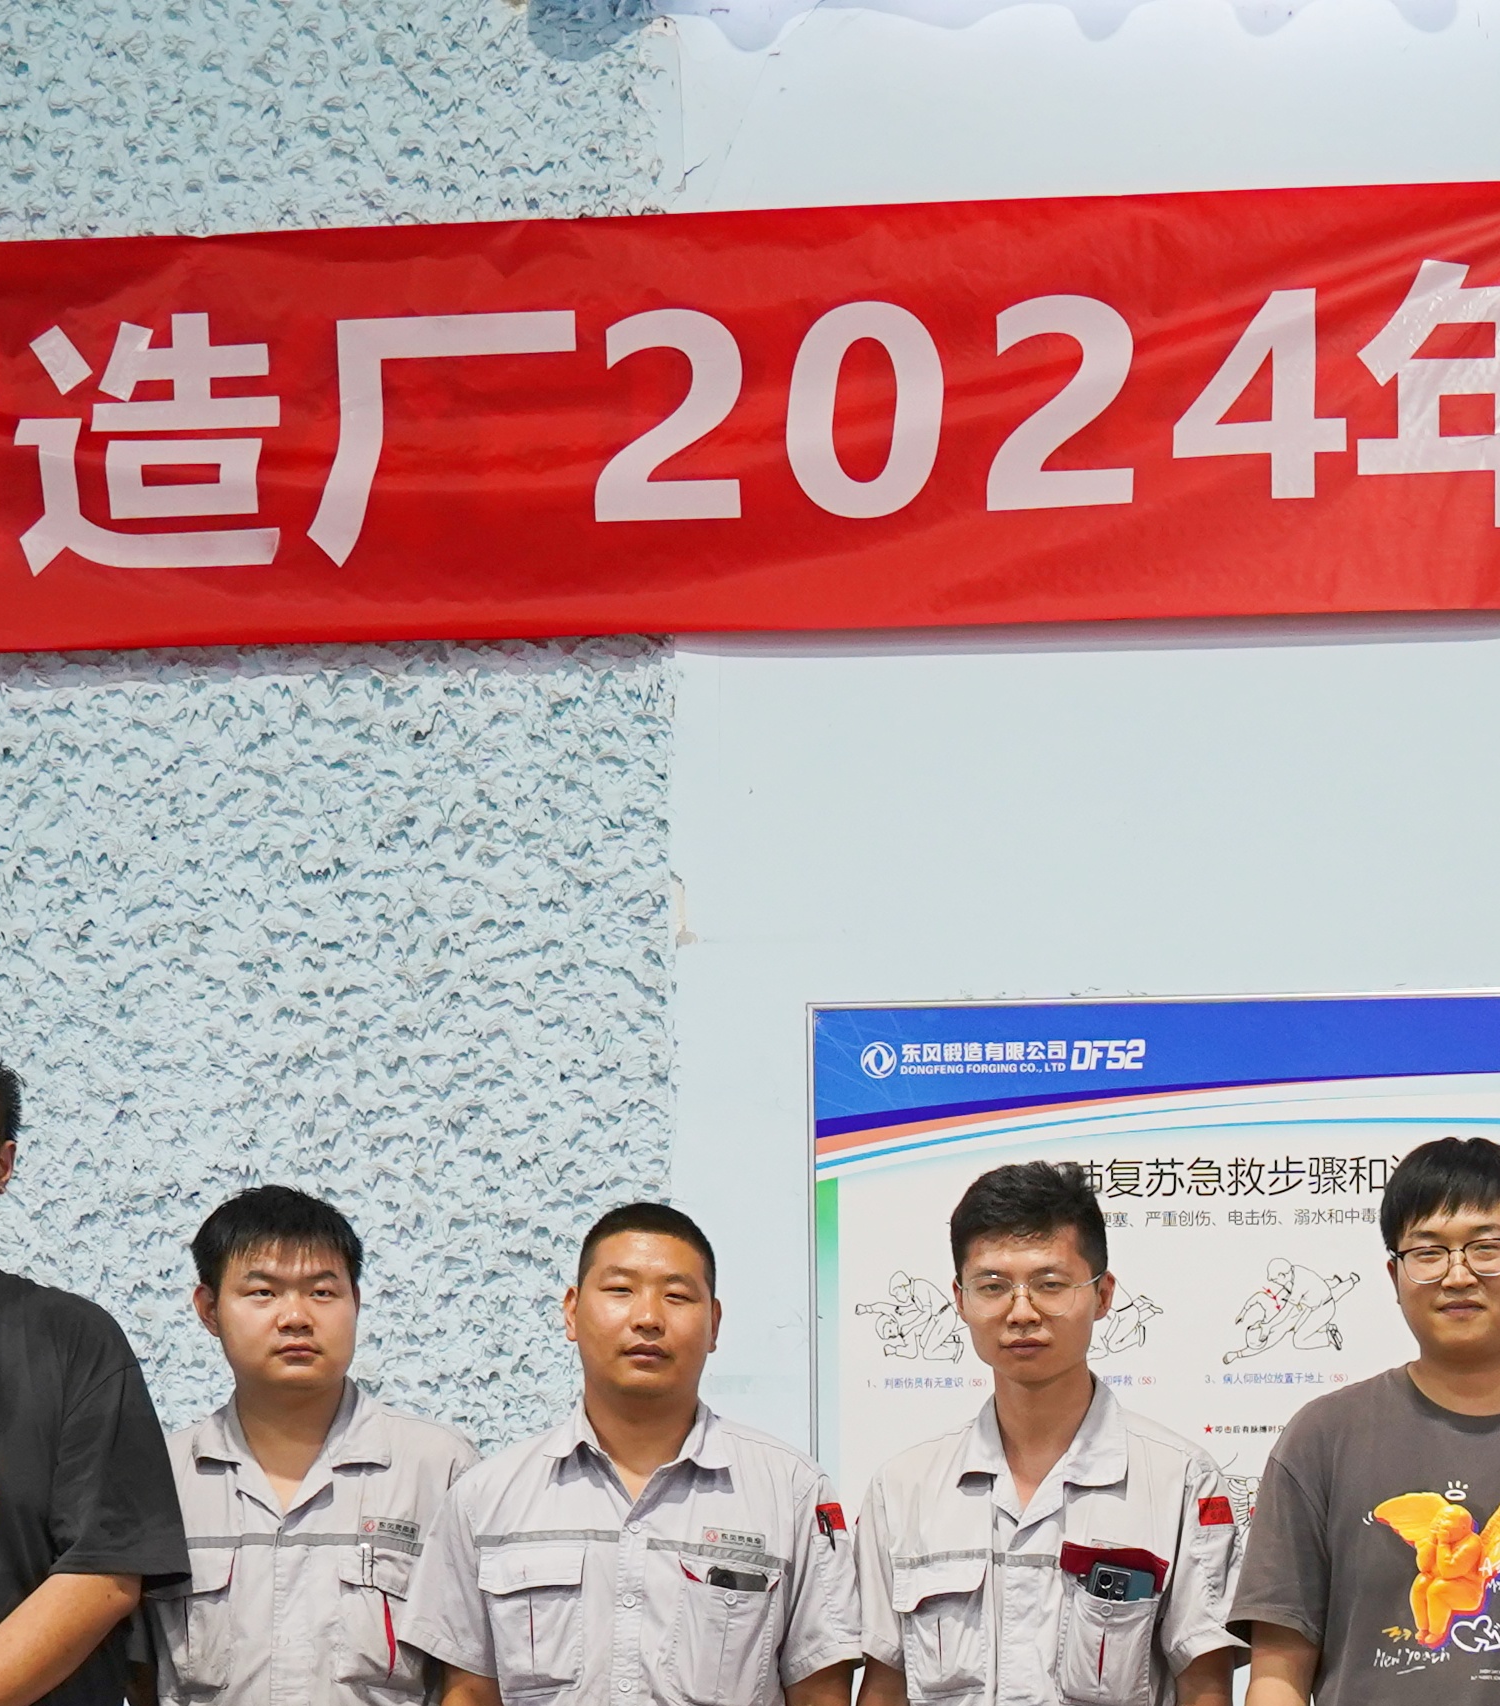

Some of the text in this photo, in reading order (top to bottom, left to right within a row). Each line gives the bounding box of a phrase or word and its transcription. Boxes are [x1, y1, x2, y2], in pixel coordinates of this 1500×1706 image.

[901, 1038, 1146, 1071] 东风锻造有限公司 DF52
[900, 1064, 964, 1076] DONGFENG
[966, 1063, 1018, 1075] FORGING
